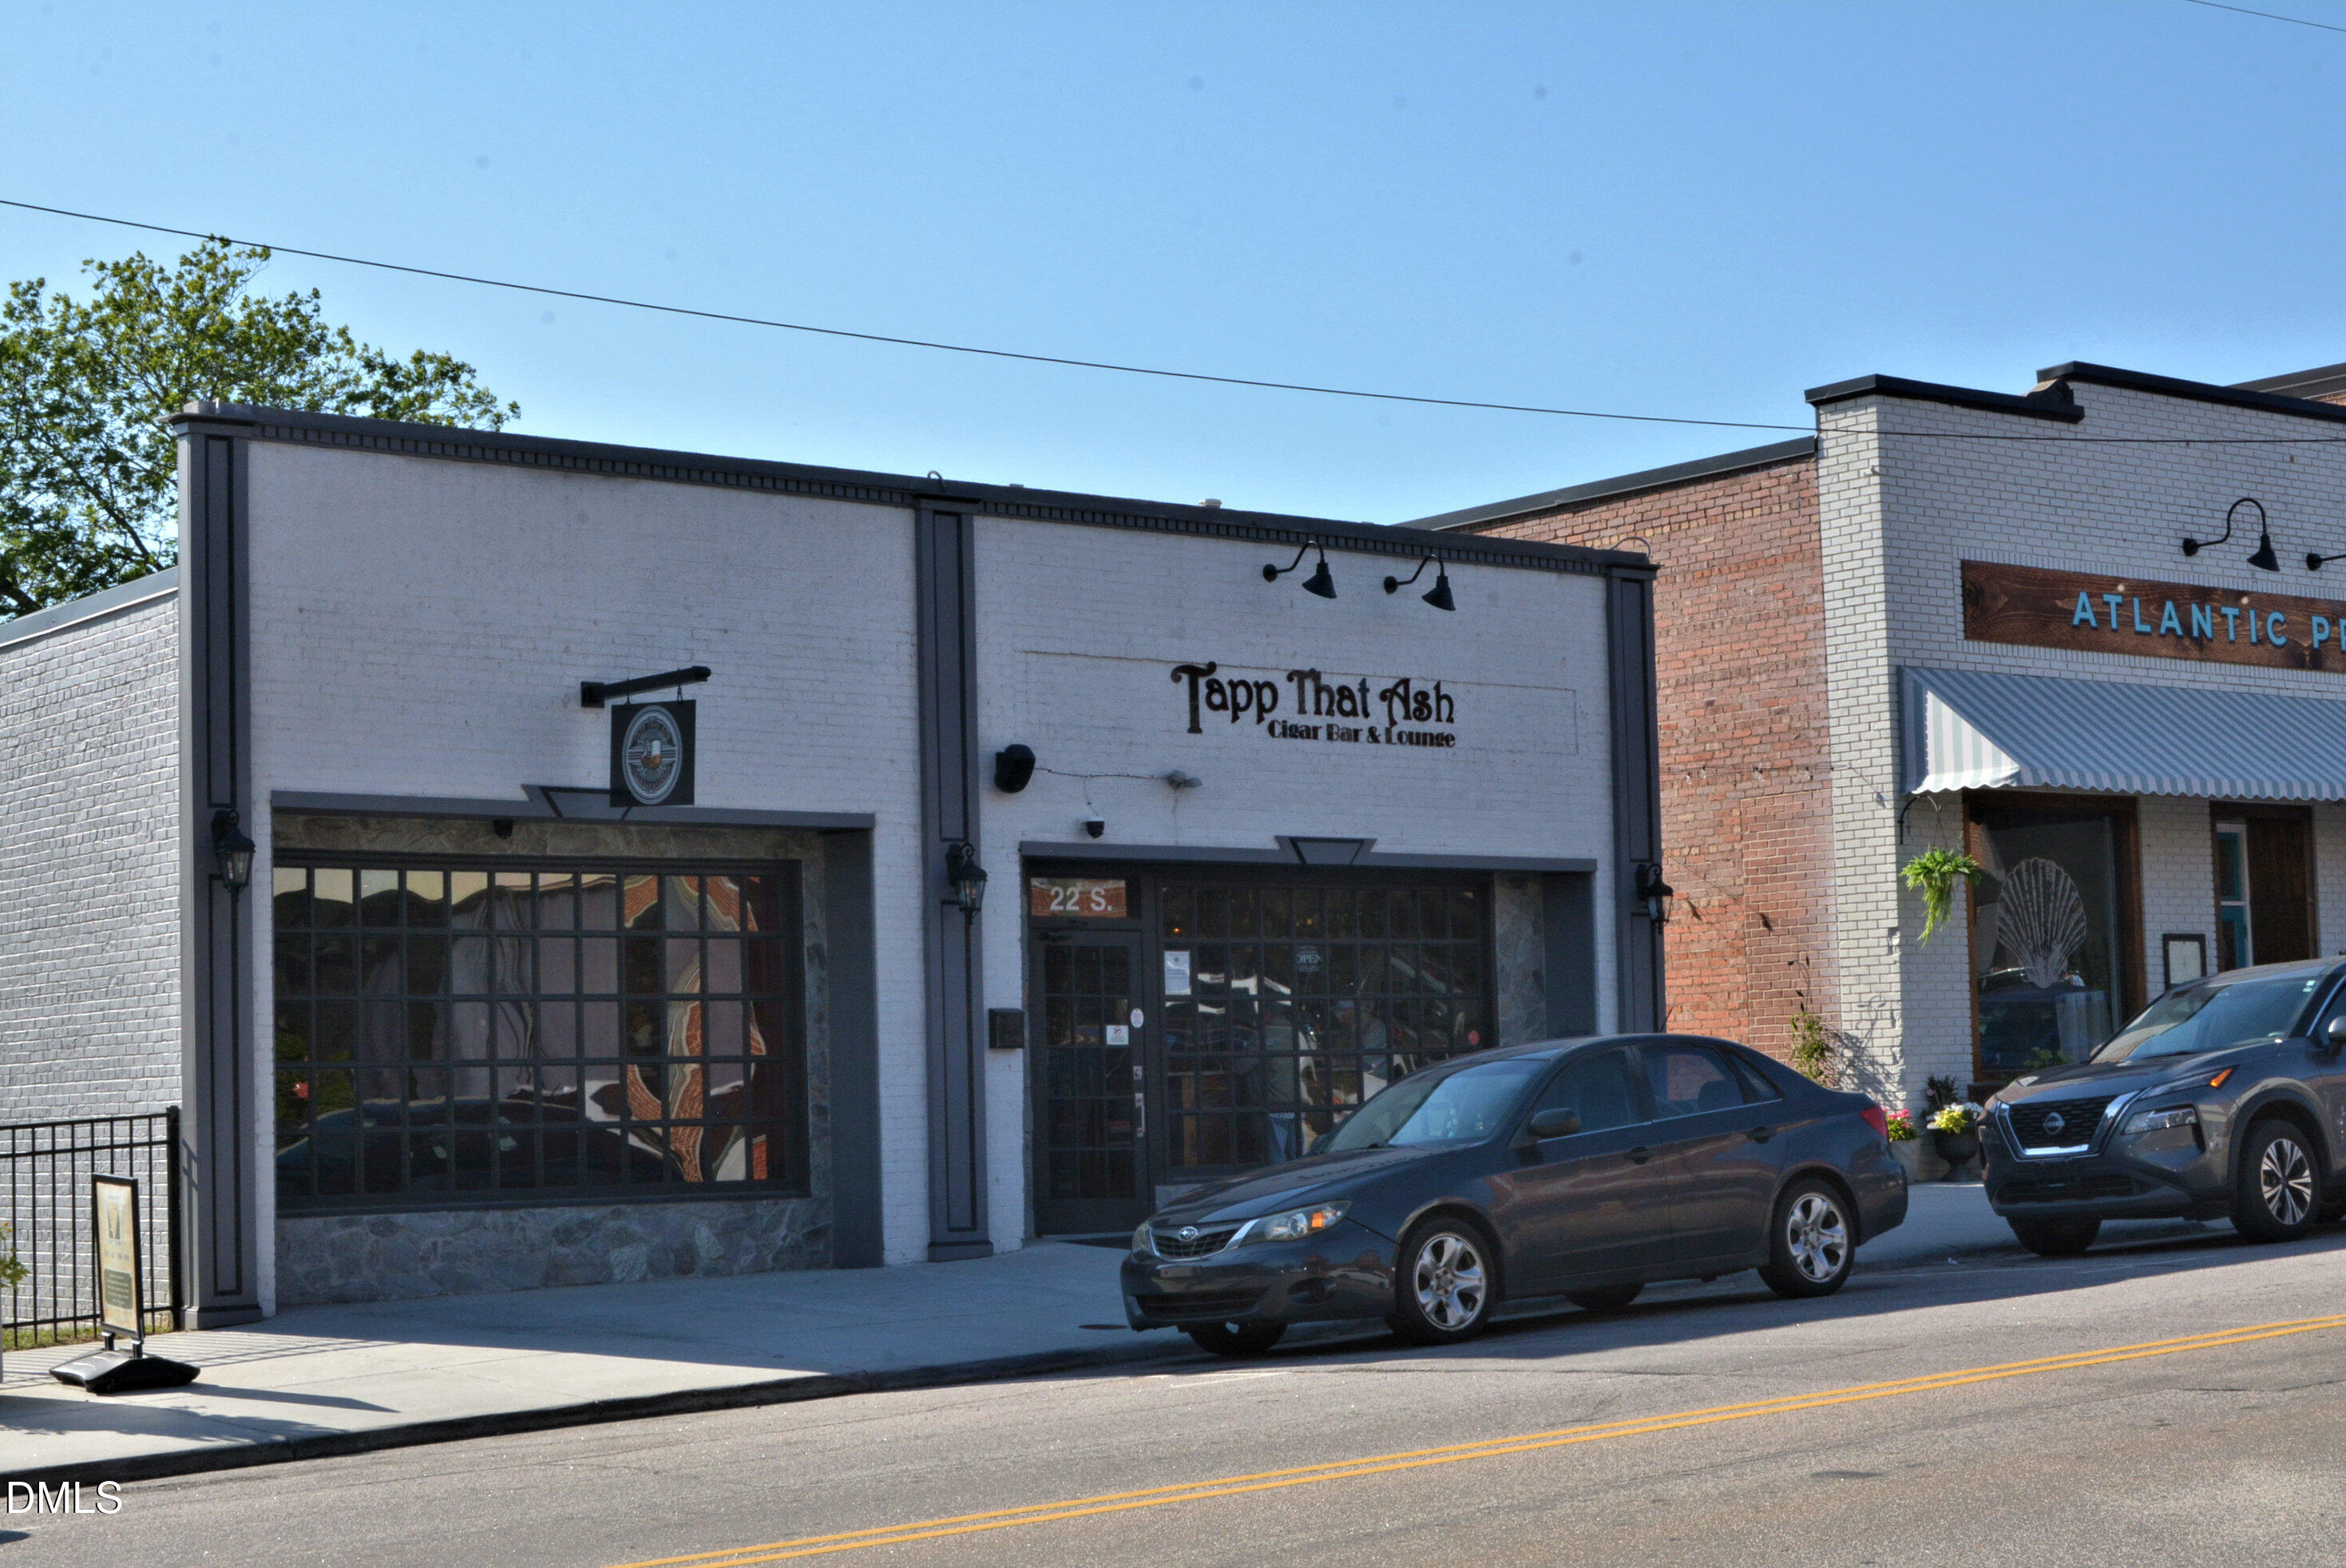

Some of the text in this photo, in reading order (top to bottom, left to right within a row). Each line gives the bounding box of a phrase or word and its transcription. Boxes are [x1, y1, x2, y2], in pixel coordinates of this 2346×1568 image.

[2072, 591, 2287, 647] ATLANTIC
[1171, 661, 1454, 734] Tapp That Ash
[1268, 719, 1456, 747] Cigar Bar & Lounge
[1050, 886, 1112, 912] 22 S.
